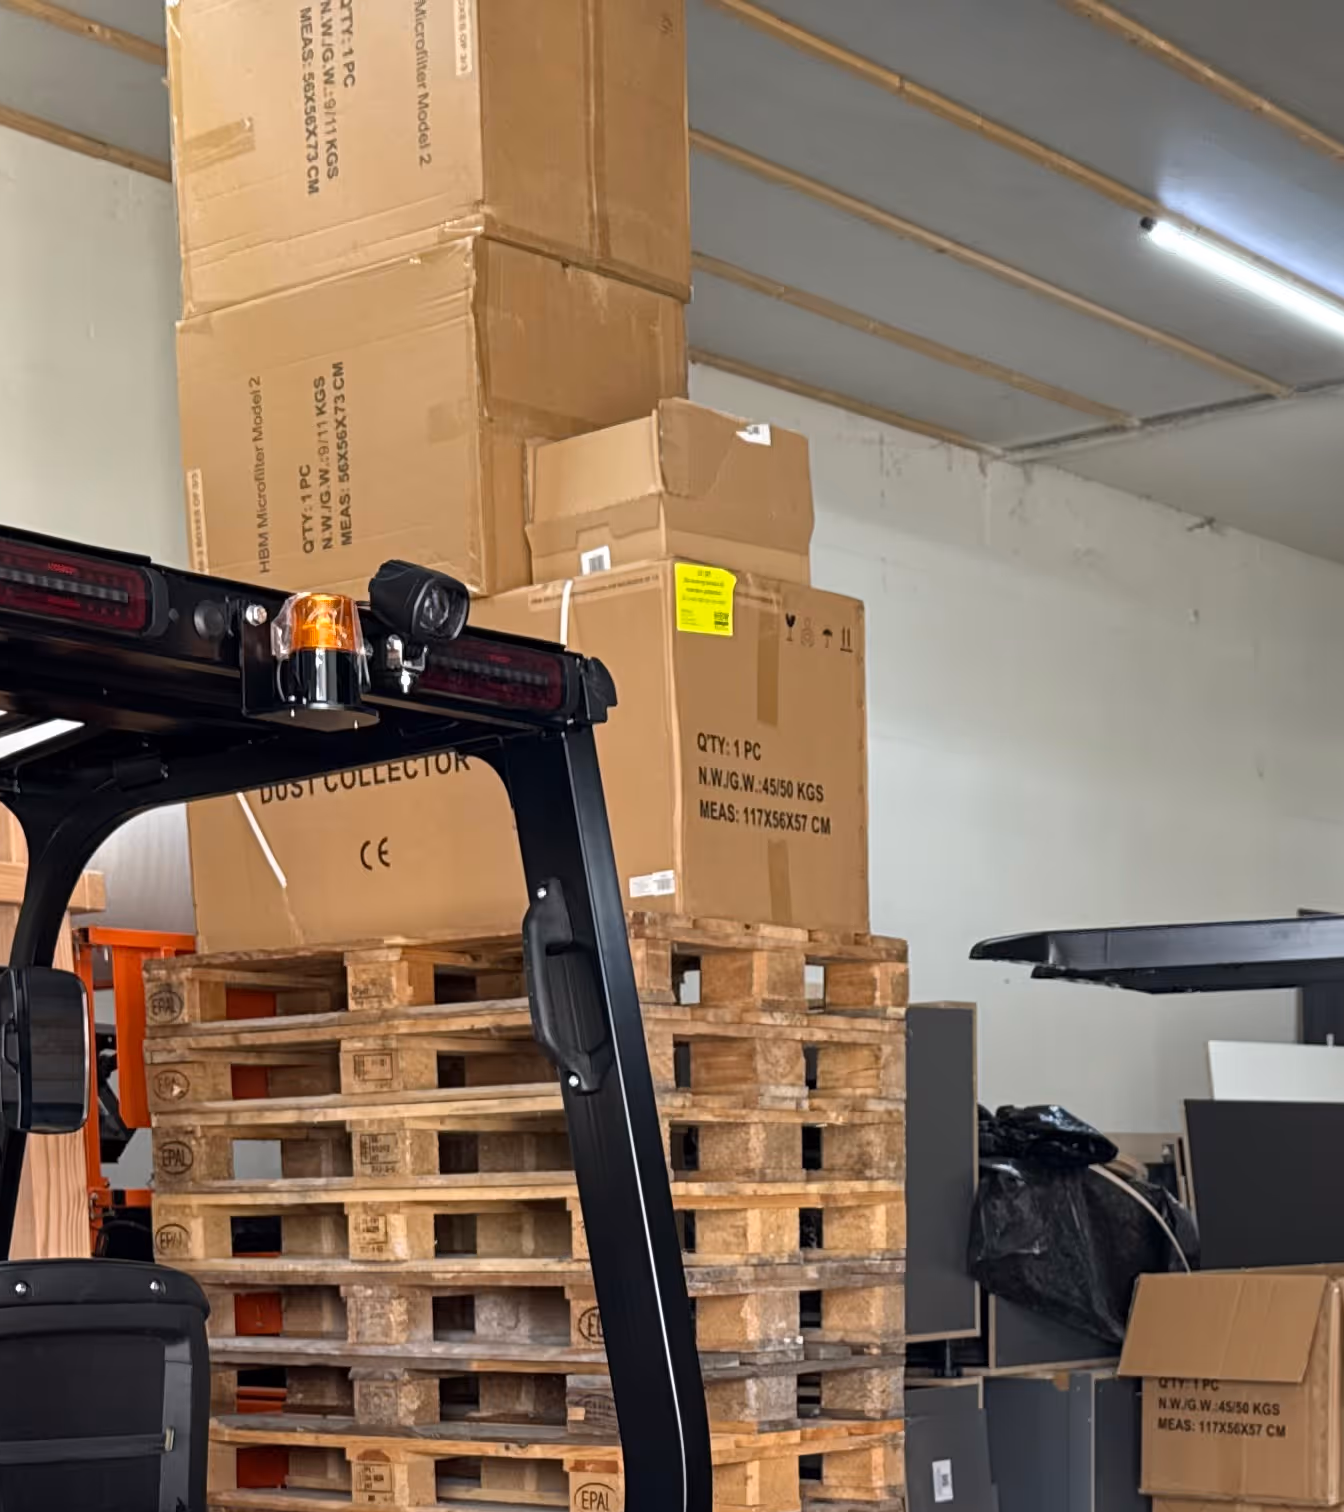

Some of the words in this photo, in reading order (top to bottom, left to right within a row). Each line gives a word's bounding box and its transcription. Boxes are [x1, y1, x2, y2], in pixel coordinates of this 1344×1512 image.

[299, 6, 315, 68] MEAS:
[342, 49, 355, 57] 1
[343, 61, 356, 88] PC
[302, 72, 319, 163] 56X56X73
[417, 92, 432, 150] Model
[325, 137, 339, 180] KGS
[419, 153, 432, 167] 2
[307, 165, 320, 196] CM
[248, 375, 261, 387] 2
[332, 361, 346, 391] CM
[313, 375, 328, 418] KGS
[250, 388, 264, 442] Model
[333, 392, 350, 483] 56X56X73
[253, 446, 268, 530] Microfilter
[299, 464, 311, 490] PC
[300, 494, 312, 503] 1
[339, 488, 353, 546] MEAS:
[258, 532, 270, 574] HBM
[734, 739, 740, 758] 1
[744, 740, 761, 761] PC
[260, 779, 315, 804] DUST
[323, 752, 471, 793] COLLECTOR
[797, 781, 824, 803] KGS
[699, 799, 740, 824] MEAS:
[743, 806, 807, 832] 117X56X57
[811, 815, 832, 835] CM
[360, 836, 391, 871] CE
[1202, 1378, 1220, 1391] PC
[1253, 1402, 1281, 1416] KGS
[1158, 1417, 1195, 1432] MEAS:
[1199, 1421, 1263, 1436] 117X56X57
[1266, 1424, 1287, 1437] CM
